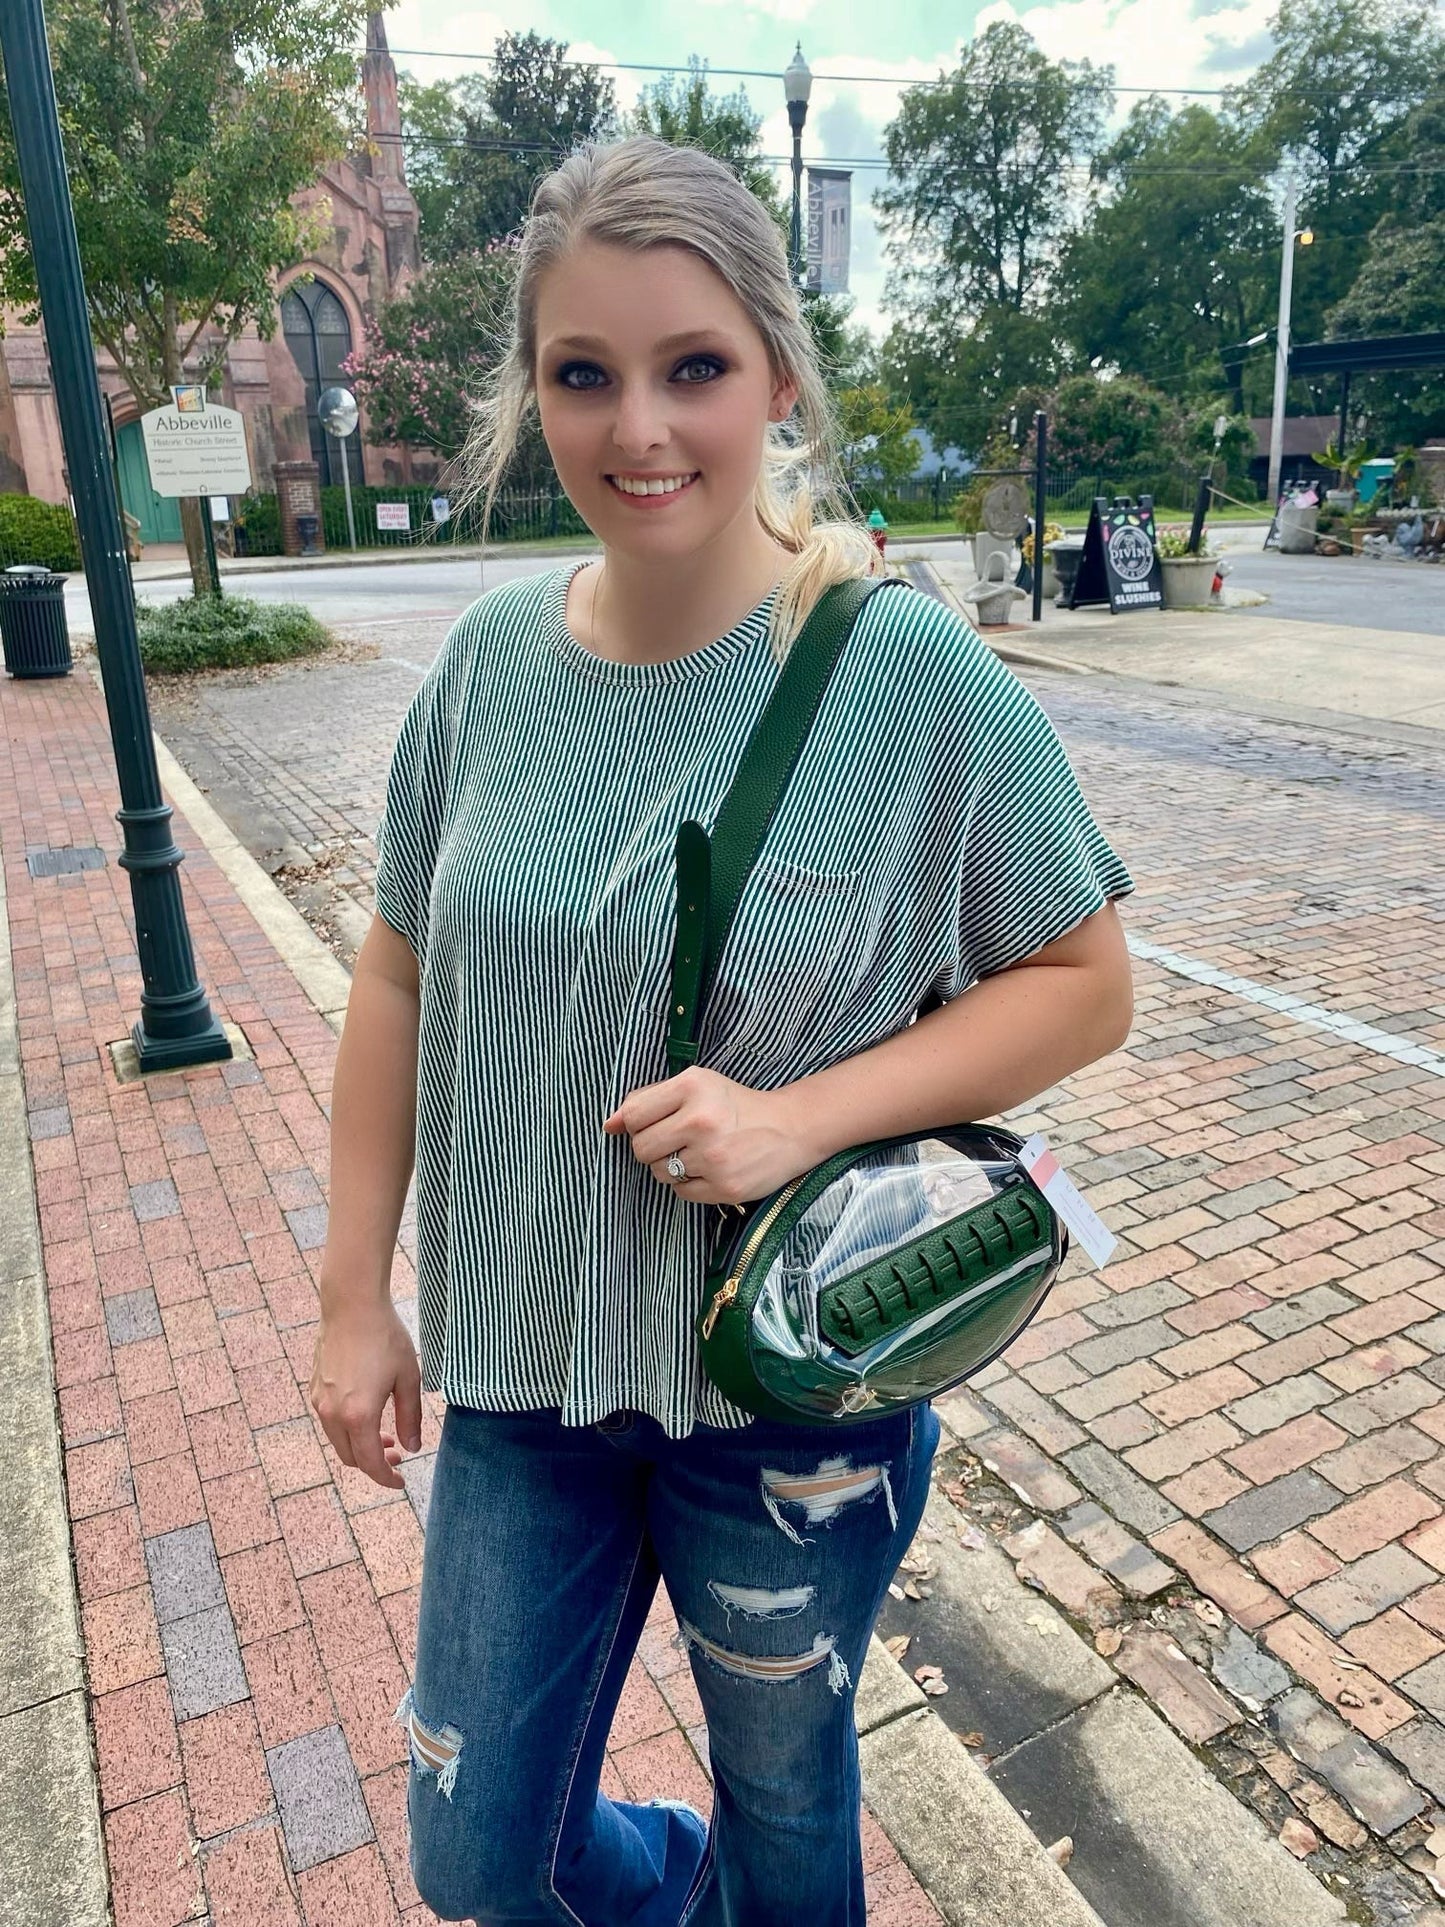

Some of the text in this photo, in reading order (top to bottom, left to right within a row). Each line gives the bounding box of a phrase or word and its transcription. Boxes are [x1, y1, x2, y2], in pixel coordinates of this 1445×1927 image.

[807, 182, 822, 277] Abbeville
[156, 415, 233, 431] Abbeville
[184, 437, 213, 446] Church
[1111, 547, 1152, 559] DIVINE
[1121, 582, 1150, 593] WINE
[1114, 592, 1161, 605] SLUSHIES
